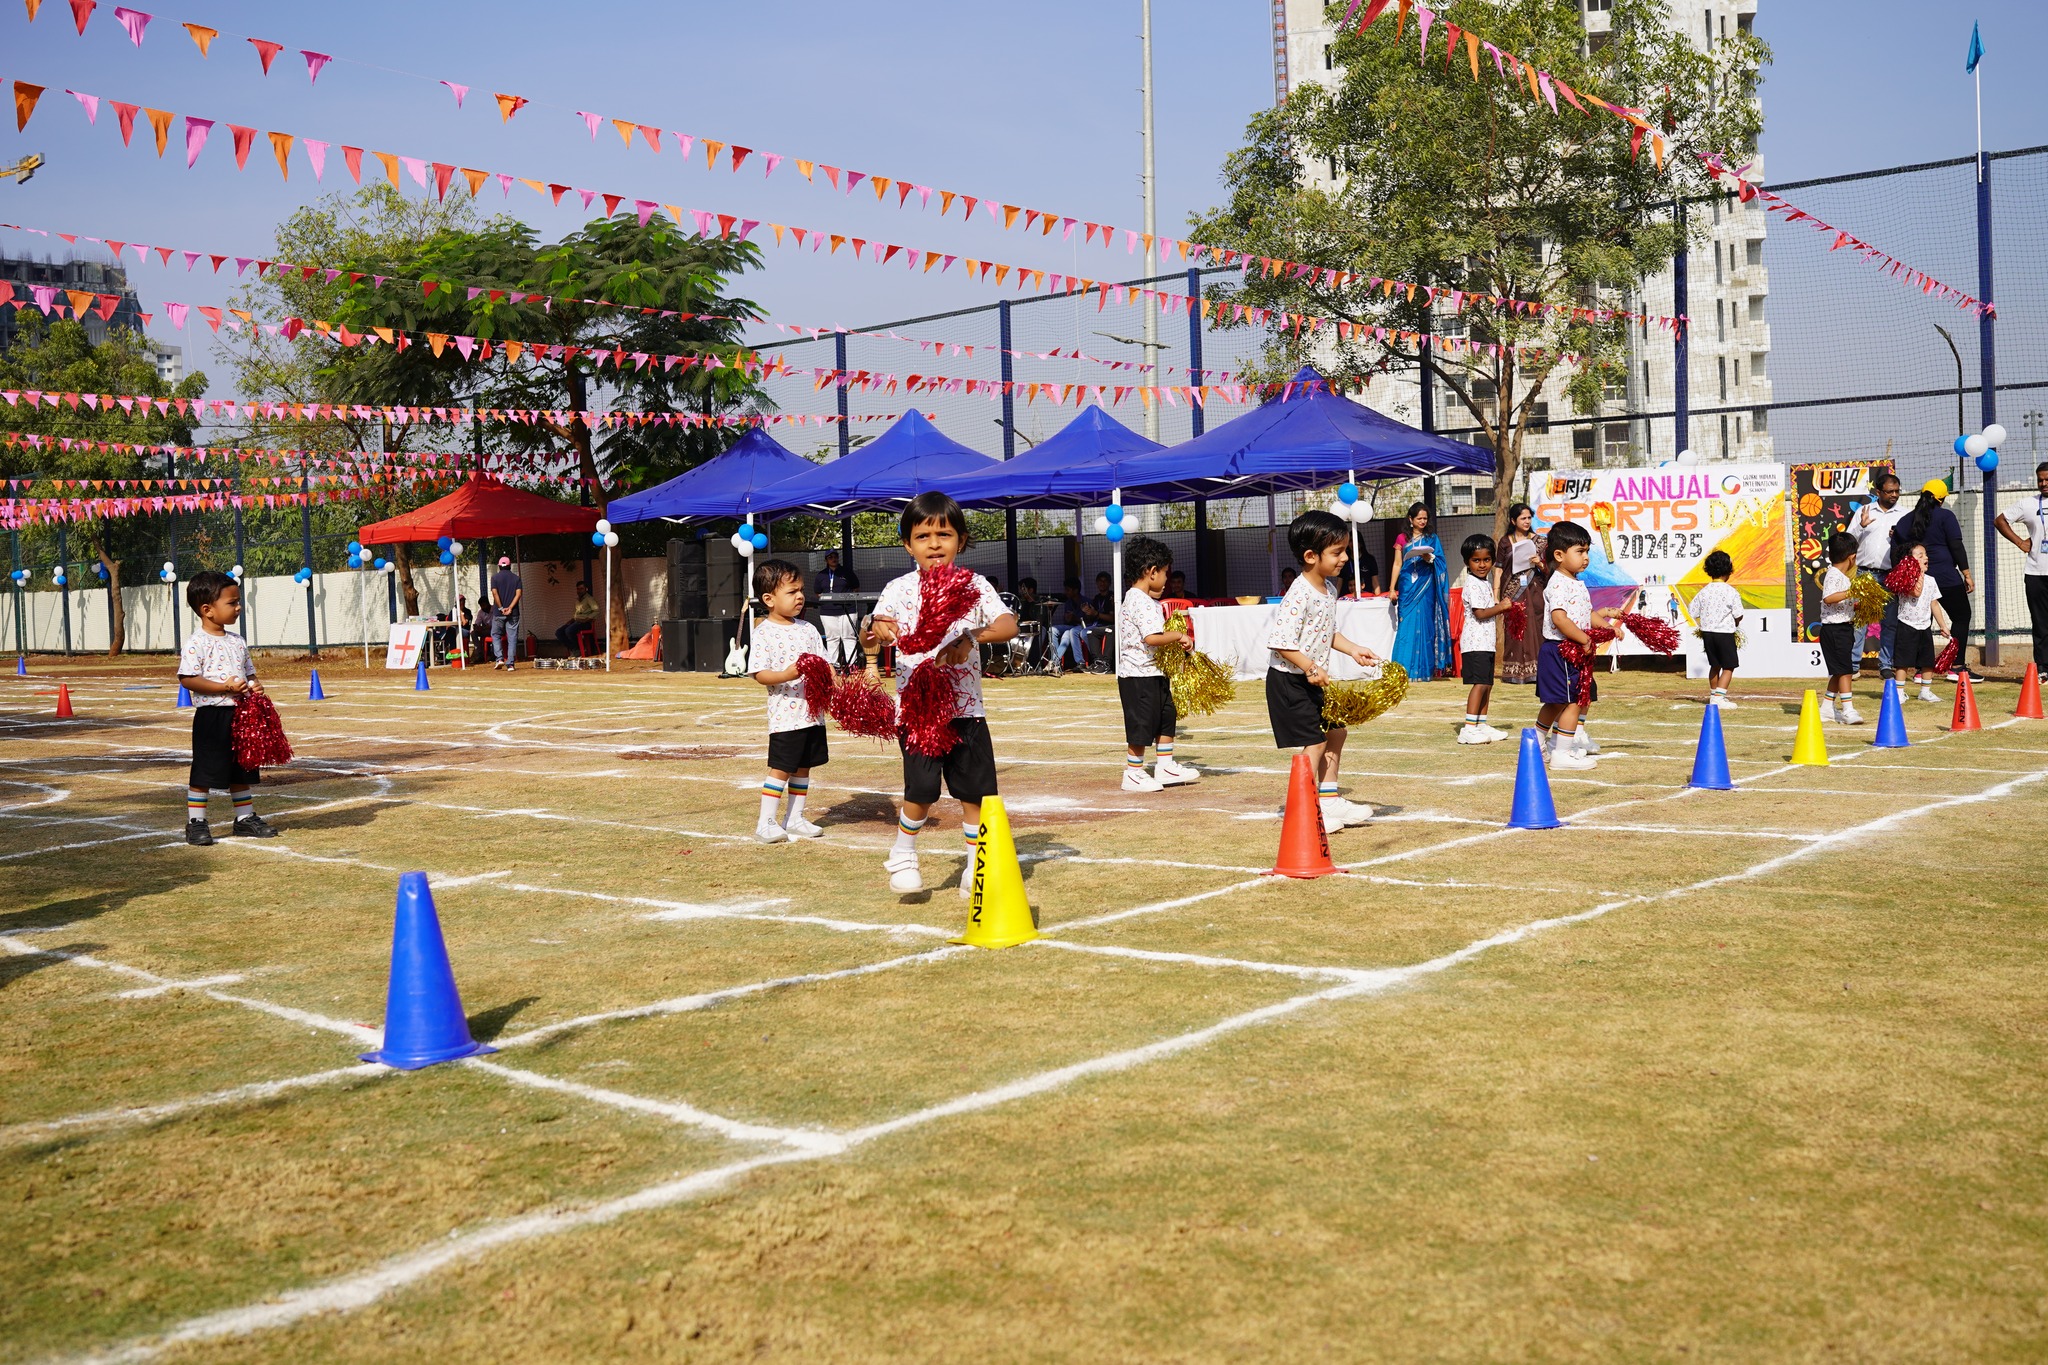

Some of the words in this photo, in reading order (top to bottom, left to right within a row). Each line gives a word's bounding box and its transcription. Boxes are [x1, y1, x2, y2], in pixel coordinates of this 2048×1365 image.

[1553, 478, 1592, 500] URJA
[1612, 474, 1720, 501] ANNUAL
[1820, 469, 1860, 494] URJA
[1536, 499, 1698, 534] SPORTS
[1709, 497, 1777, 530] DAY
[1617, 533, 1703, 559] 2024-25
[1760, 616, 1770, 633] 1
[1810, 649, 1822, 666] 3
[973, 842, 986, 922] KAIZEN
